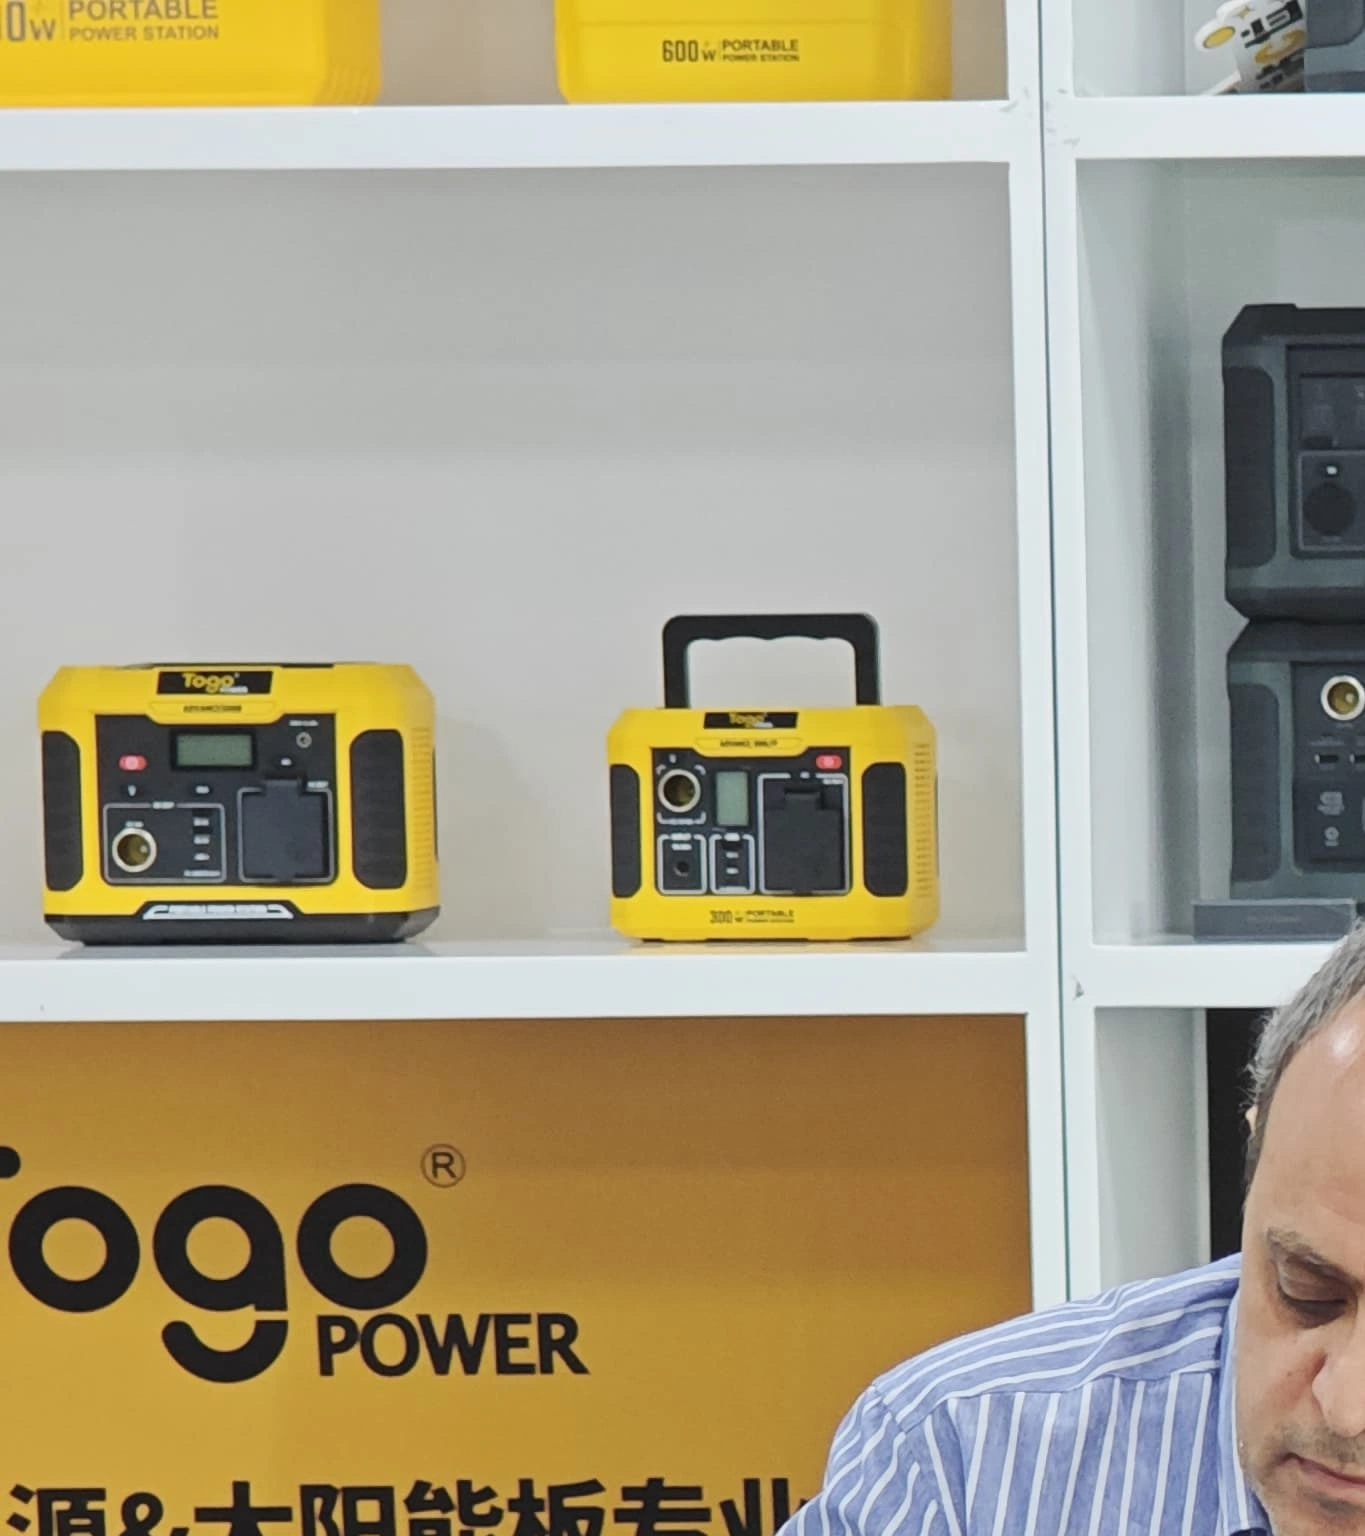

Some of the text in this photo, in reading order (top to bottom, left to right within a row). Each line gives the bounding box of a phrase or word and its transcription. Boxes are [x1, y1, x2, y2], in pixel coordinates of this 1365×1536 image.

[68, 0, 219, 20] PORTABLE
[69, 25, 219, 41] POWER STATION
[722, 39, 799, 51] PORTABLE
[182, 672, 235, 693] Togo
[0, 1146, 428, 1383] ogo
[318, 1313, 590, 1377] POWER
